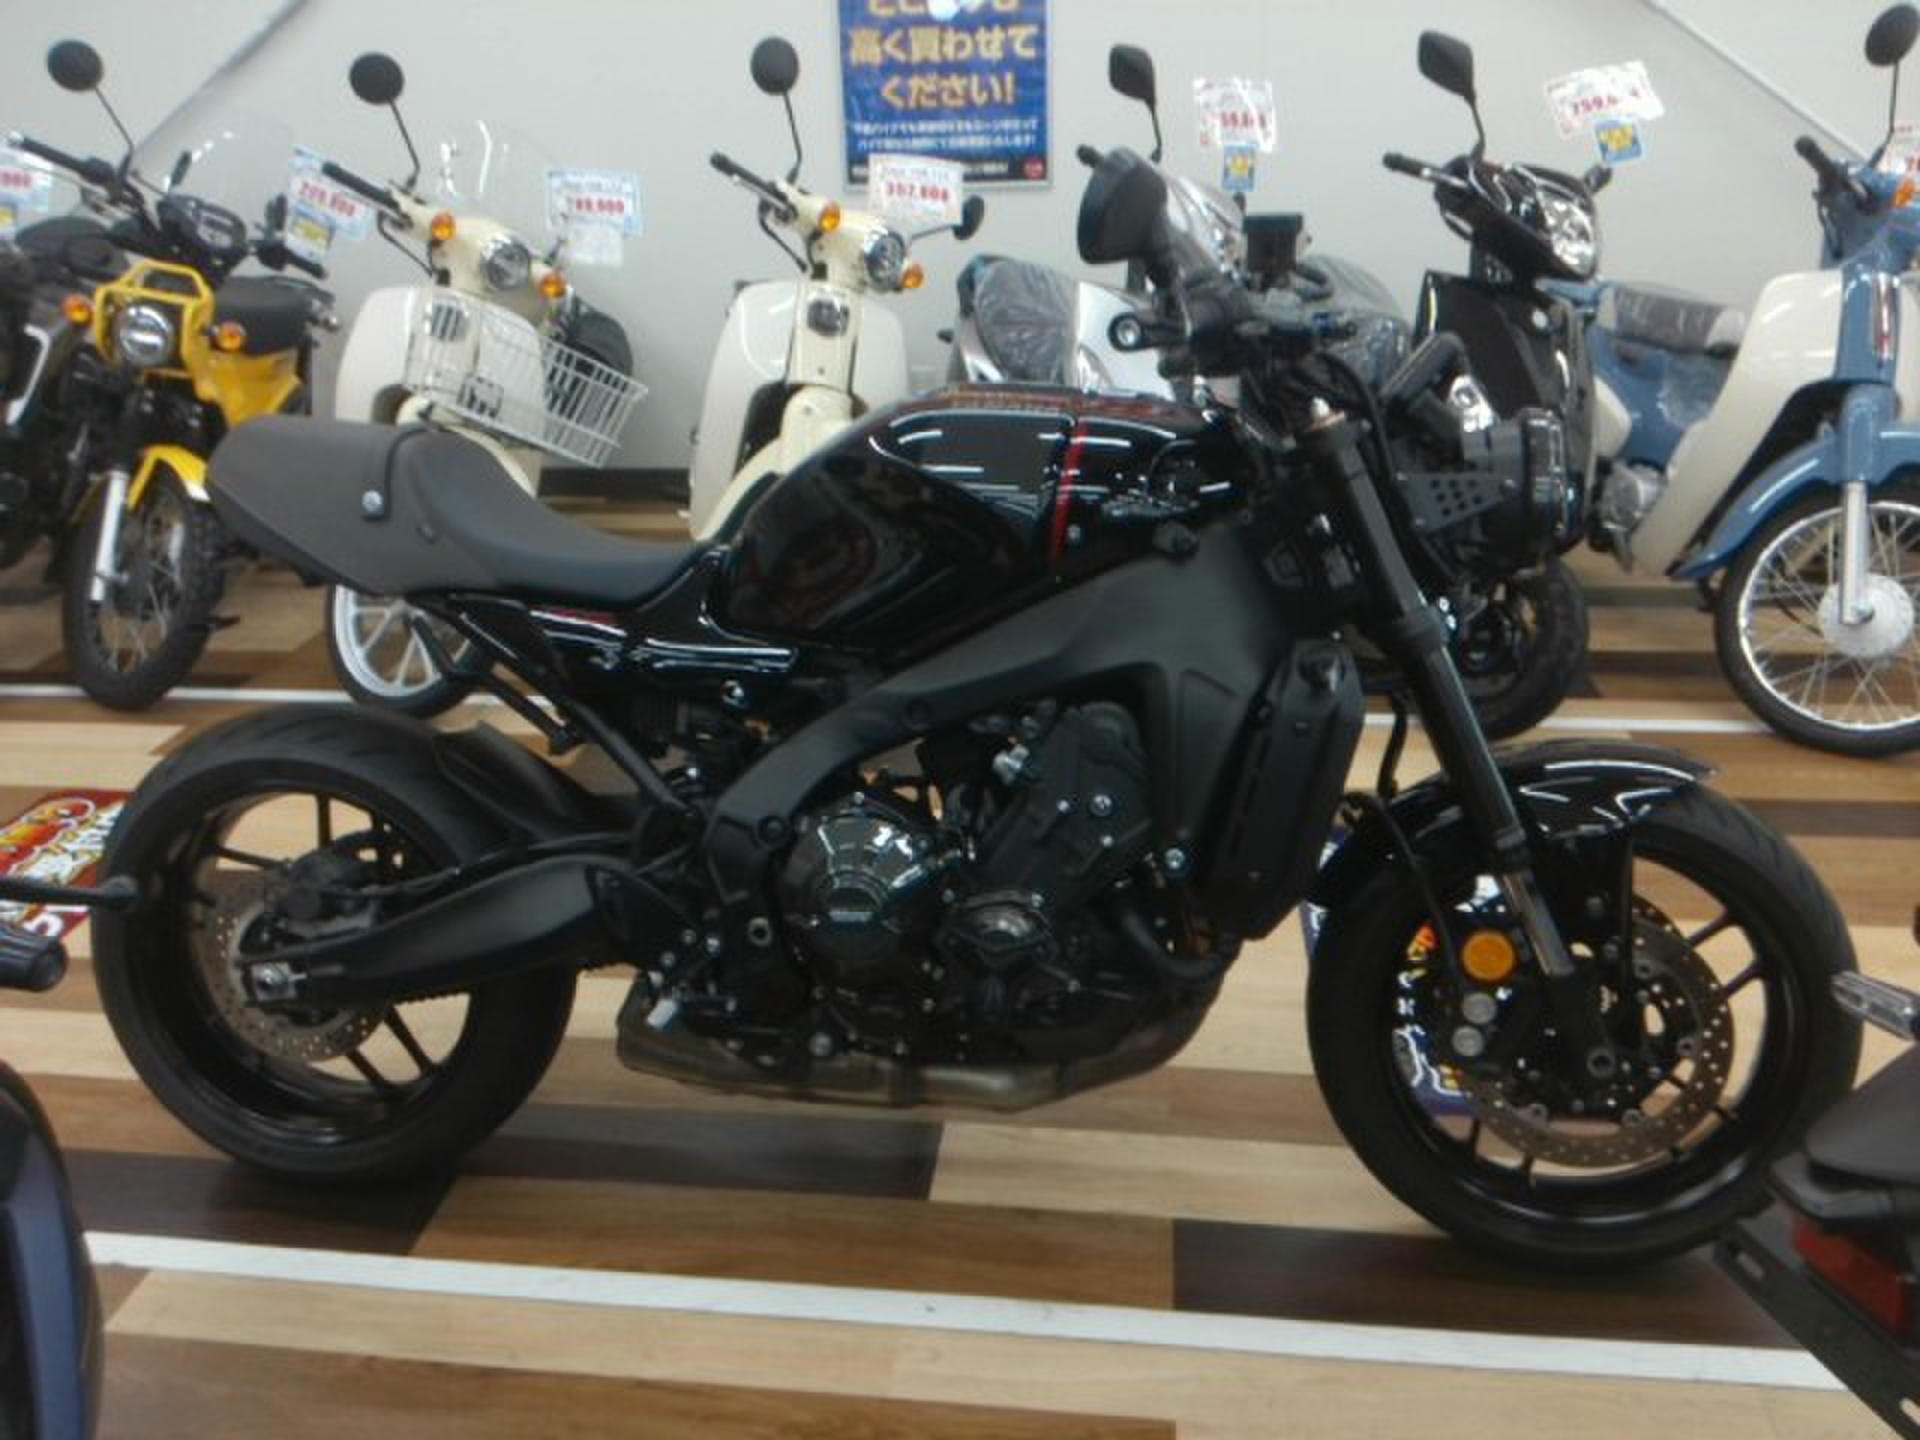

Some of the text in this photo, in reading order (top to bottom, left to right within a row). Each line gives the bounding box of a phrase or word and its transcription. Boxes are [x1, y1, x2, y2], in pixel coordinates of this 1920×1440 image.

[850, 25, 1039, 66] 高く買わせて
[881, 71, 1015, 109] ください!
